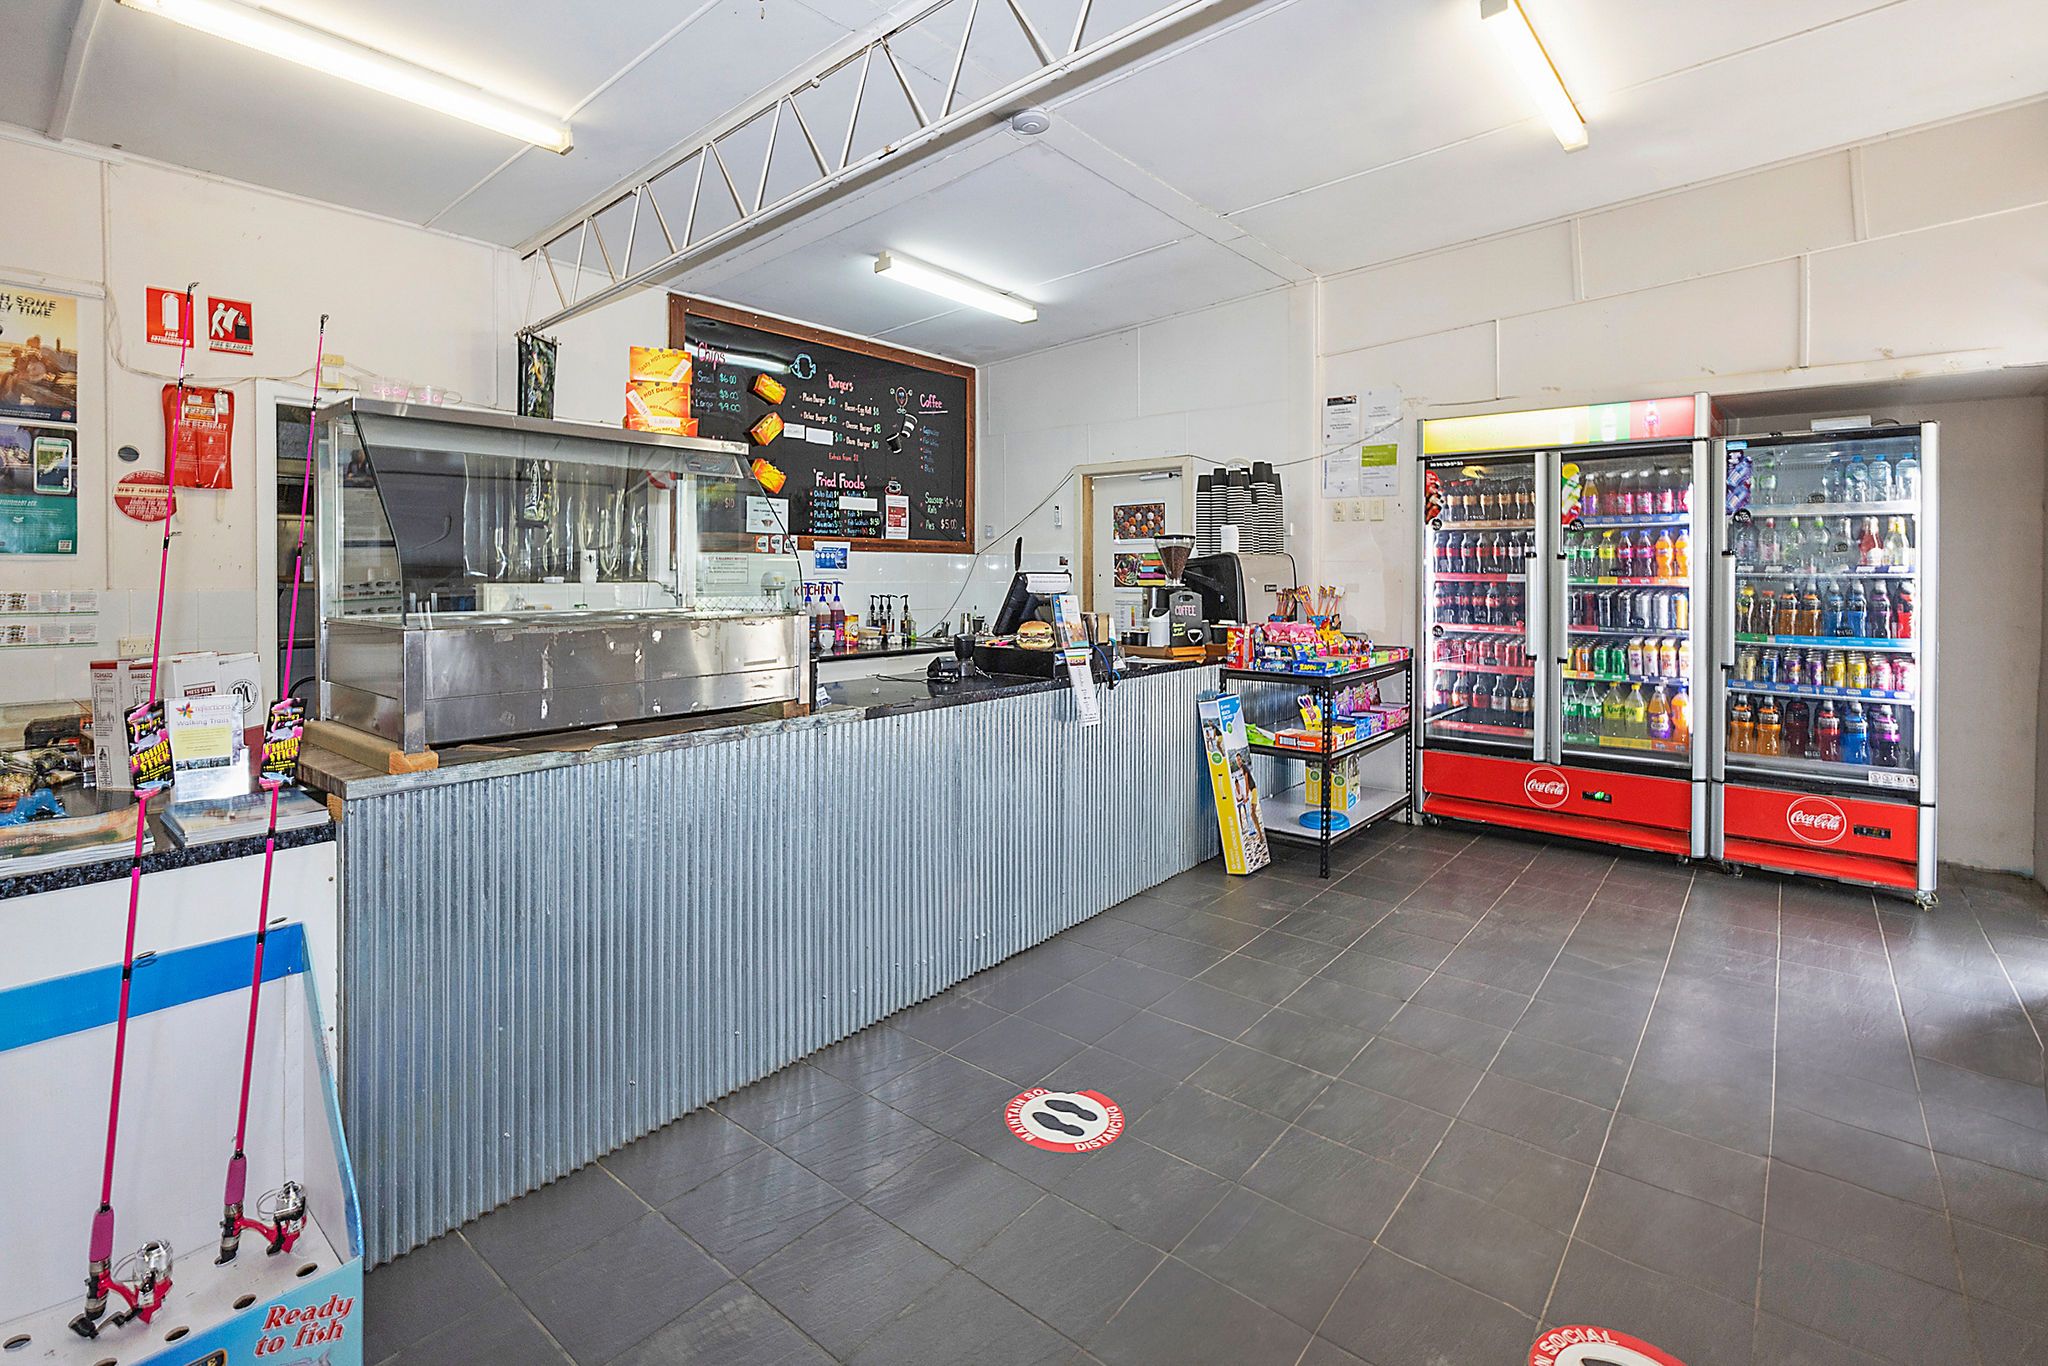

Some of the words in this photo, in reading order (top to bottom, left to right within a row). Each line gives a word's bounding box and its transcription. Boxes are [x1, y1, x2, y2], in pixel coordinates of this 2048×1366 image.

[16, 295, 57, 311] SOME
[20, 306, 53, 318] TIME
[827, 373, 854, 395] Burgers
[919, 393, 943, 409] Coffee
[925, 491, 944, 508] Sausage
[1174, 605, 1197, 617] COFFEE
[269, 747, 298, 763] STICK
[1527, 778, 1566, 796] Coca-Cola
[1790, 809, 1842, 831] Coca-Cola
[1007, 1098, 1037, 1142] MAINTAIN
[1074, 1105, 1123, 1152] DISTANCING
[262, 1293, 356, 1332] Ready
[254, 1334, 286, 1358] to
[292, 1318, 346, 1349] fish
[1539, 1327, 1619, 1356] SOCIAL
